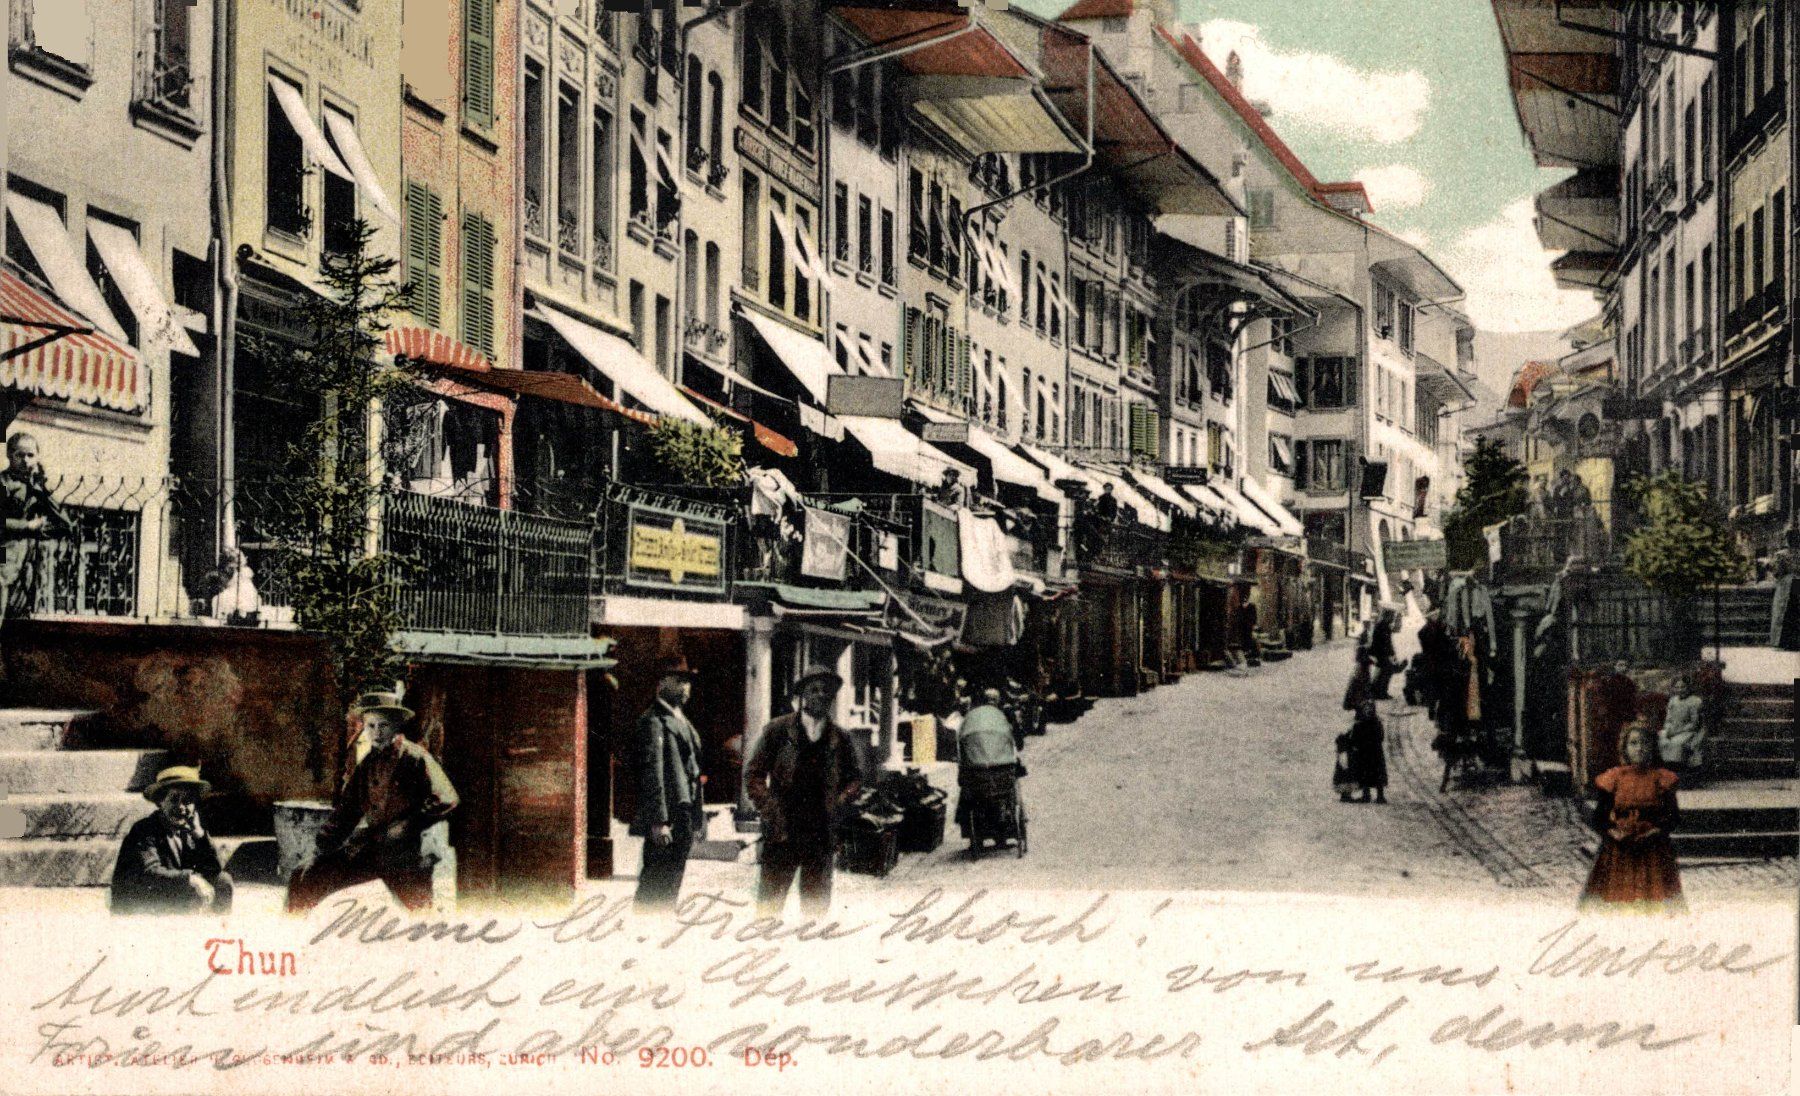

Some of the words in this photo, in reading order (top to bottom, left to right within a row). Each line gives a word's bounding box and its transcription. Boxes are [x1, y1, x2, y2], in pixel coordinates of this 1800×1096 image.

[309, 898, 523, 945] Meine
[660, 890, 870, 950] Frau
[233, 954, 524, 1015] endlich
[539, 957, 686, 1010] ein
[1166, 963, 1307, 994] von
[1528, 919, 1792, 979] Unsere
[515, 1008, 676, 1060] aber
[1429, 1004, 1710, 1052] denn
